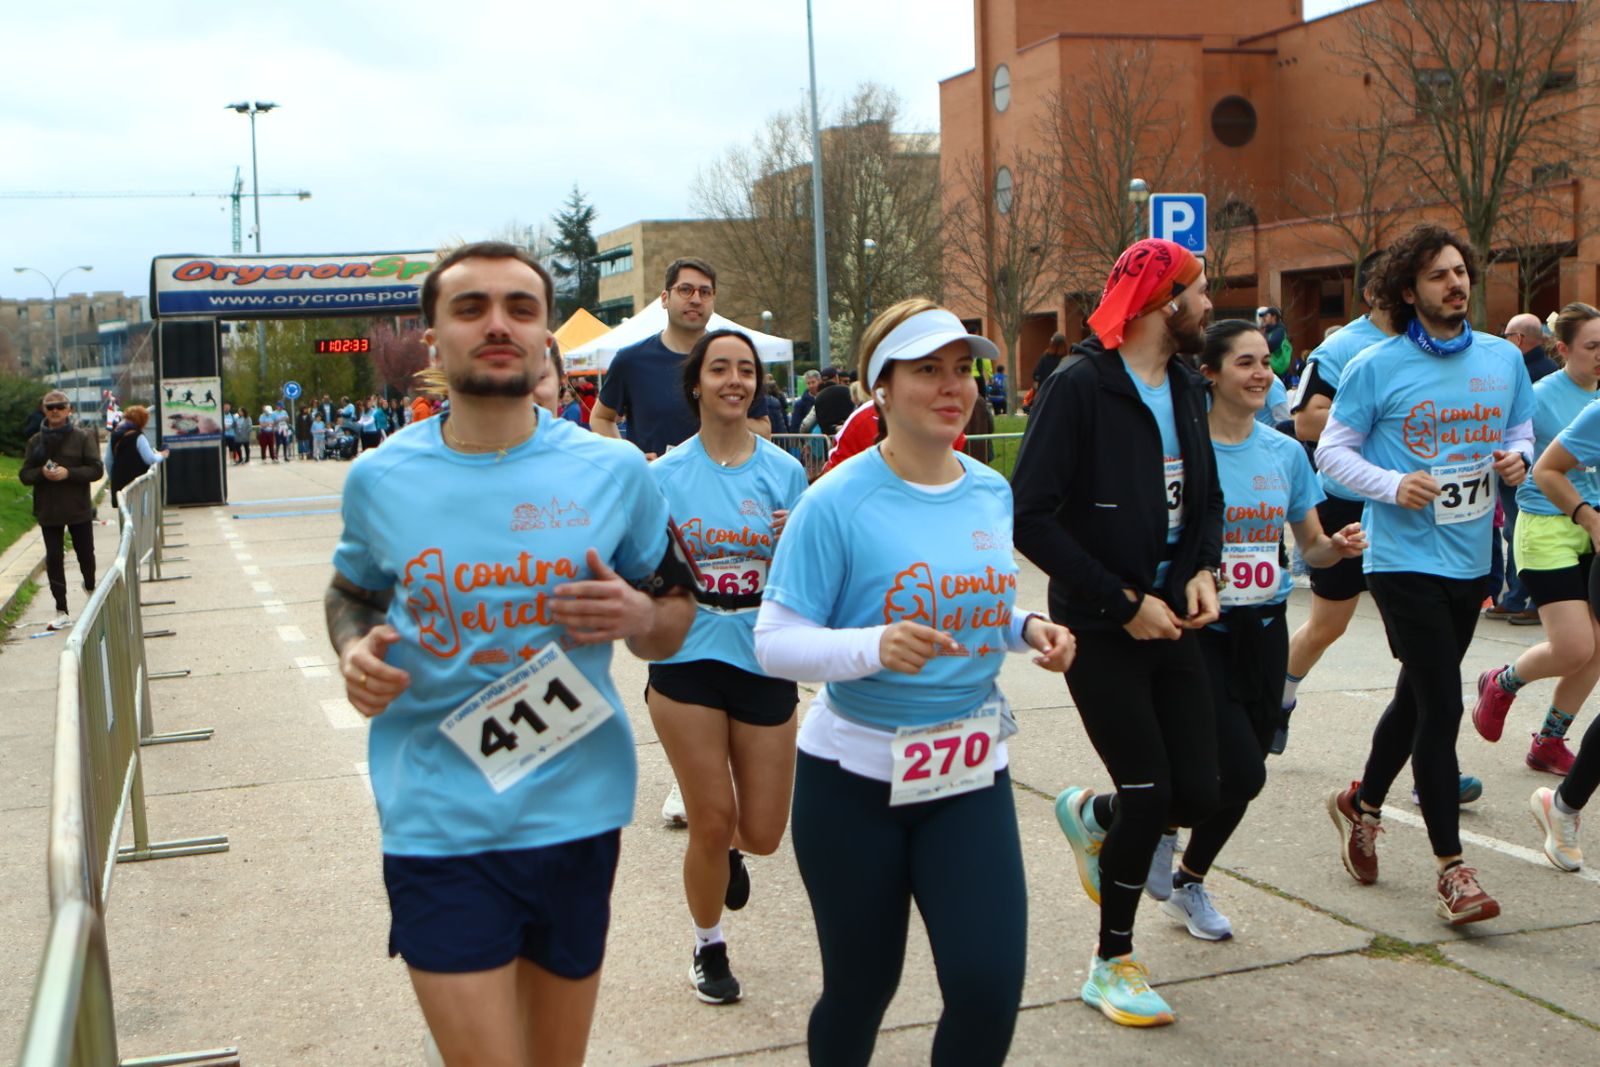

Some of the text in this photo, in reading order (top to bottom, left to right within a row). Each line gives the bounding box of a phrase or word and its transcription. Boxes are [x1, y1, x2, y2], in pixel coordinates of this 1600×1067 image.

[1163, 201, 1196, 241] P
[321, 339, 368, 352] 11:02:33
[1440, 402, 1502, 423] contra
[1441, 427, 1460, 445] el
[1441, 472, 1490, 509] 371
[706, 526, 771, 547] contra
[454, 551, 578, 592] contra
[461, 591, 556, 633] el ict
[942, 607, 967, 631] el
[481, 677, 582, 757] 411
[902, 731, 990, 782] 270
